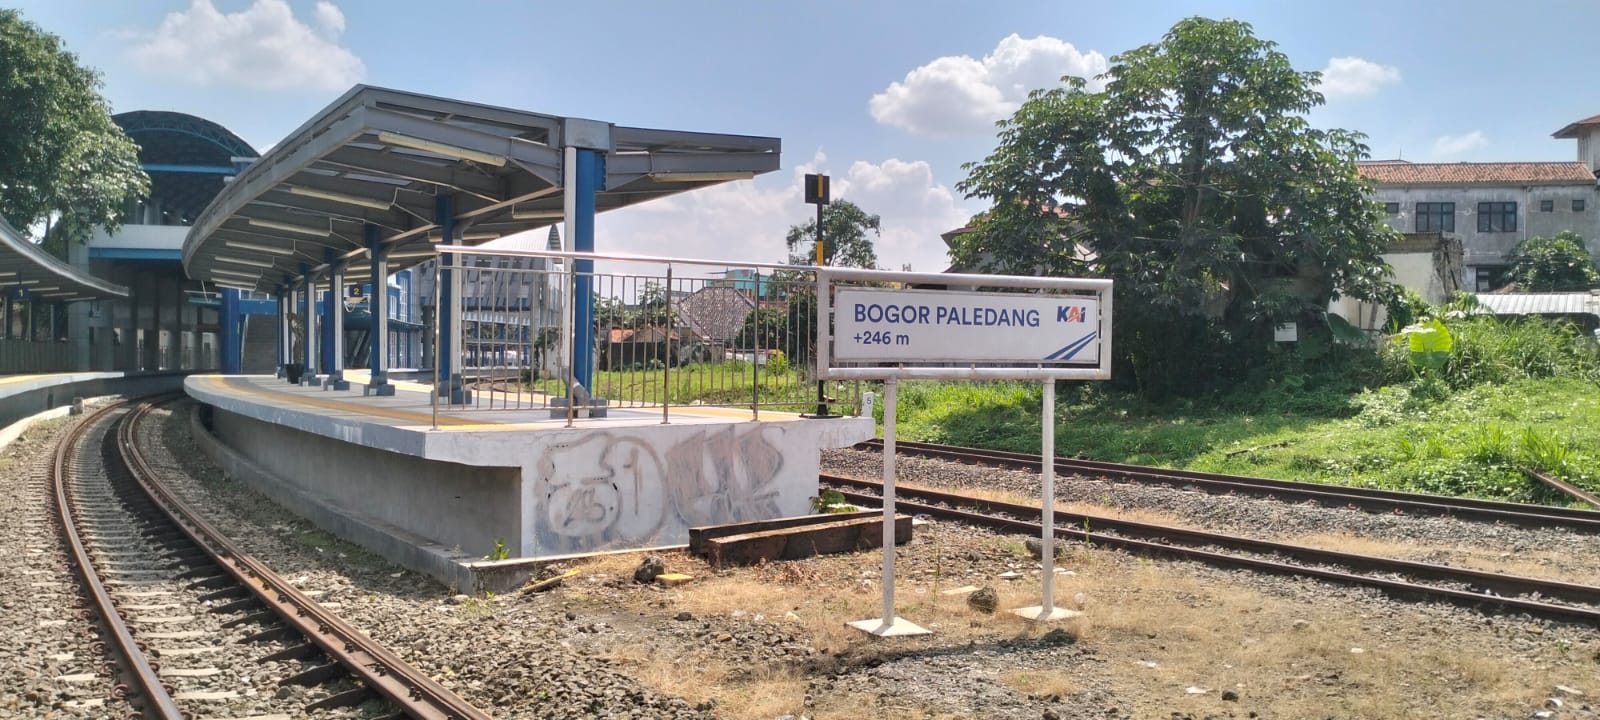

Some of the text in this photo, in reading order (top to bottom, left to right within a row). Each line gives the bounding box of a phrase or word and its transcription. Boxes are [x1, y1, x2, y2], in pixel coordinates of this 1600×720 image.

[353, 287, 360, 296] 2
[854, 303, 1040, 327] BOGOR PALEDANG
[853, 331, 910, 345] +246 m
